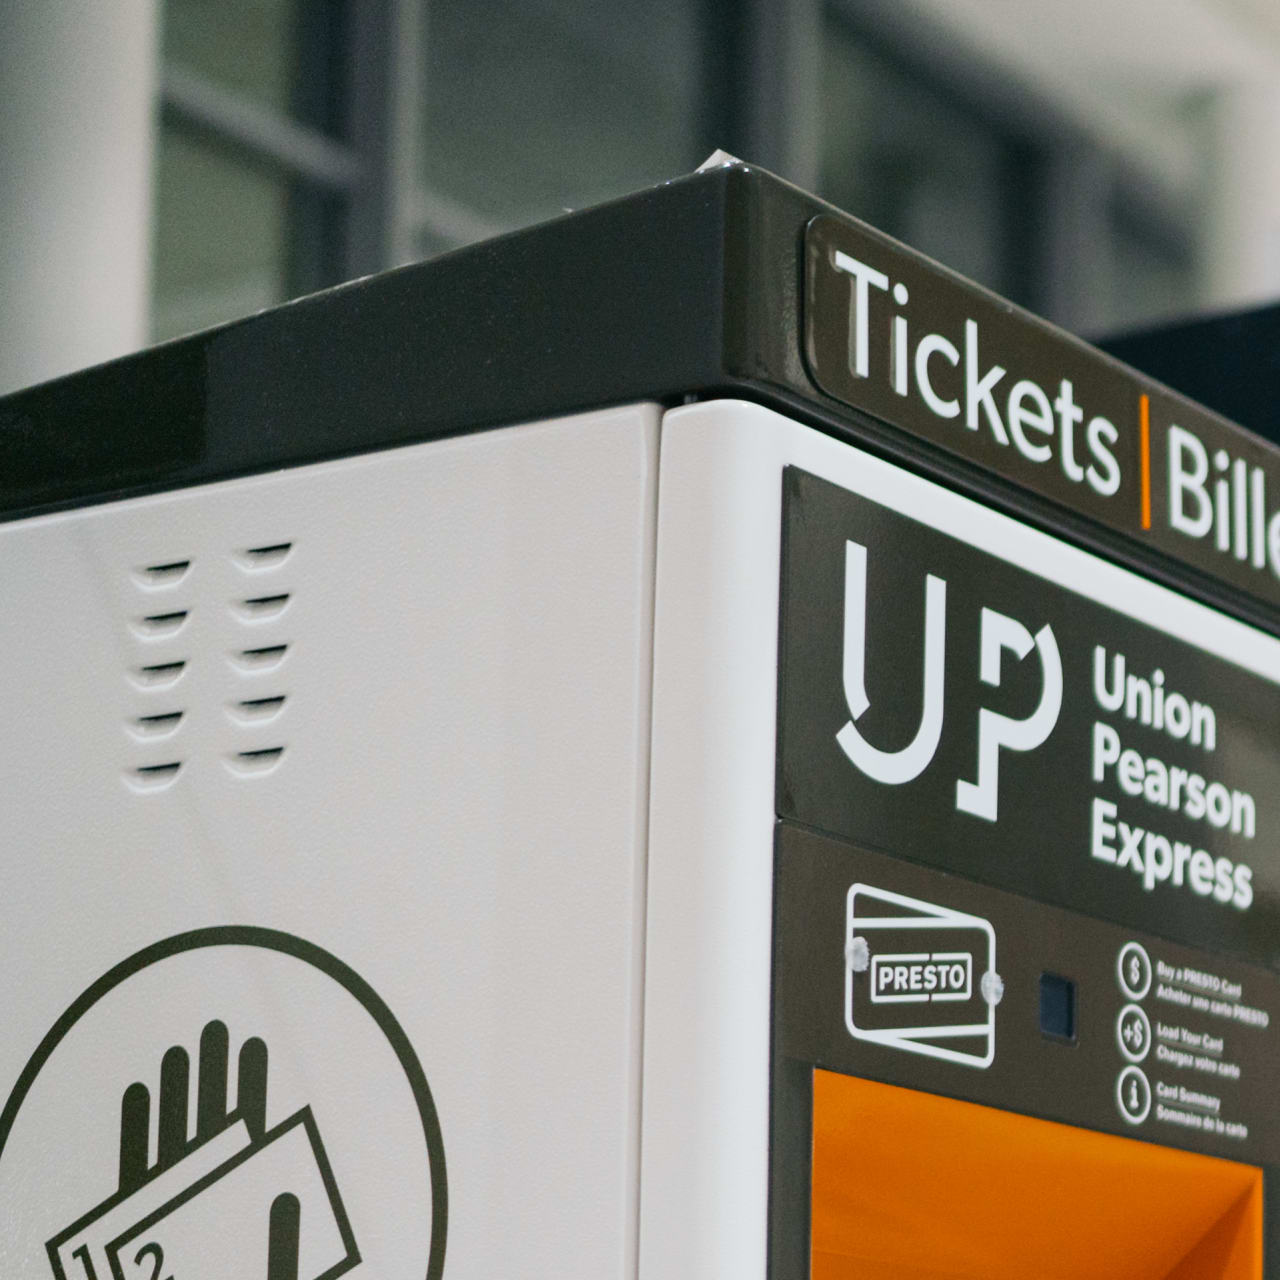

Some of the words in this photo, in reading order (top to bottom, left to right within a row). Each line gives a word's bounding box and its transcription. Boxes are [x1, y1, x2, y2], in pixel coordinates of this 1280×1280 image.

[835, 250, 1121, 496] Tickets
[836, 539, 1063, 822] UP
[1093, 645, 1216, 751] Union
[1092, 720, 1256, 839] Pearson
[1091, 797, 1253, 910] Express
[879, 964, 965, 991] PRESTO
[1157, 960, 1174, 982] Buy
[1176, 969, 1182, 979] a
[1184, 968, 1220, 991] PRESTO
[1221, 980, 1242, 998] Card
[1157, 984, 1191, 1006] Acheter
[1234, 1004, 1269, 1028] PRESTO
[1157, 1022, 1180, 1040] Load
[1180, 1027, 1202, 1046] Your
[1202, 1034, 1224, 1052] Card
[1157, 1045, 1194, 1067] Chargez
[1195, 1057, 1217, 1073] votre
[1218, 1062, 1240, 1079] carte
[1157, 1081, 1178, 1100] Card
[1179, 1088, 1221, 1113] Summary
[1157, 1104, 1201, 1127] Sommaire
[1203, 1114, 1214, 1129] de
[1226, 1121, 1248, 1139] carte
